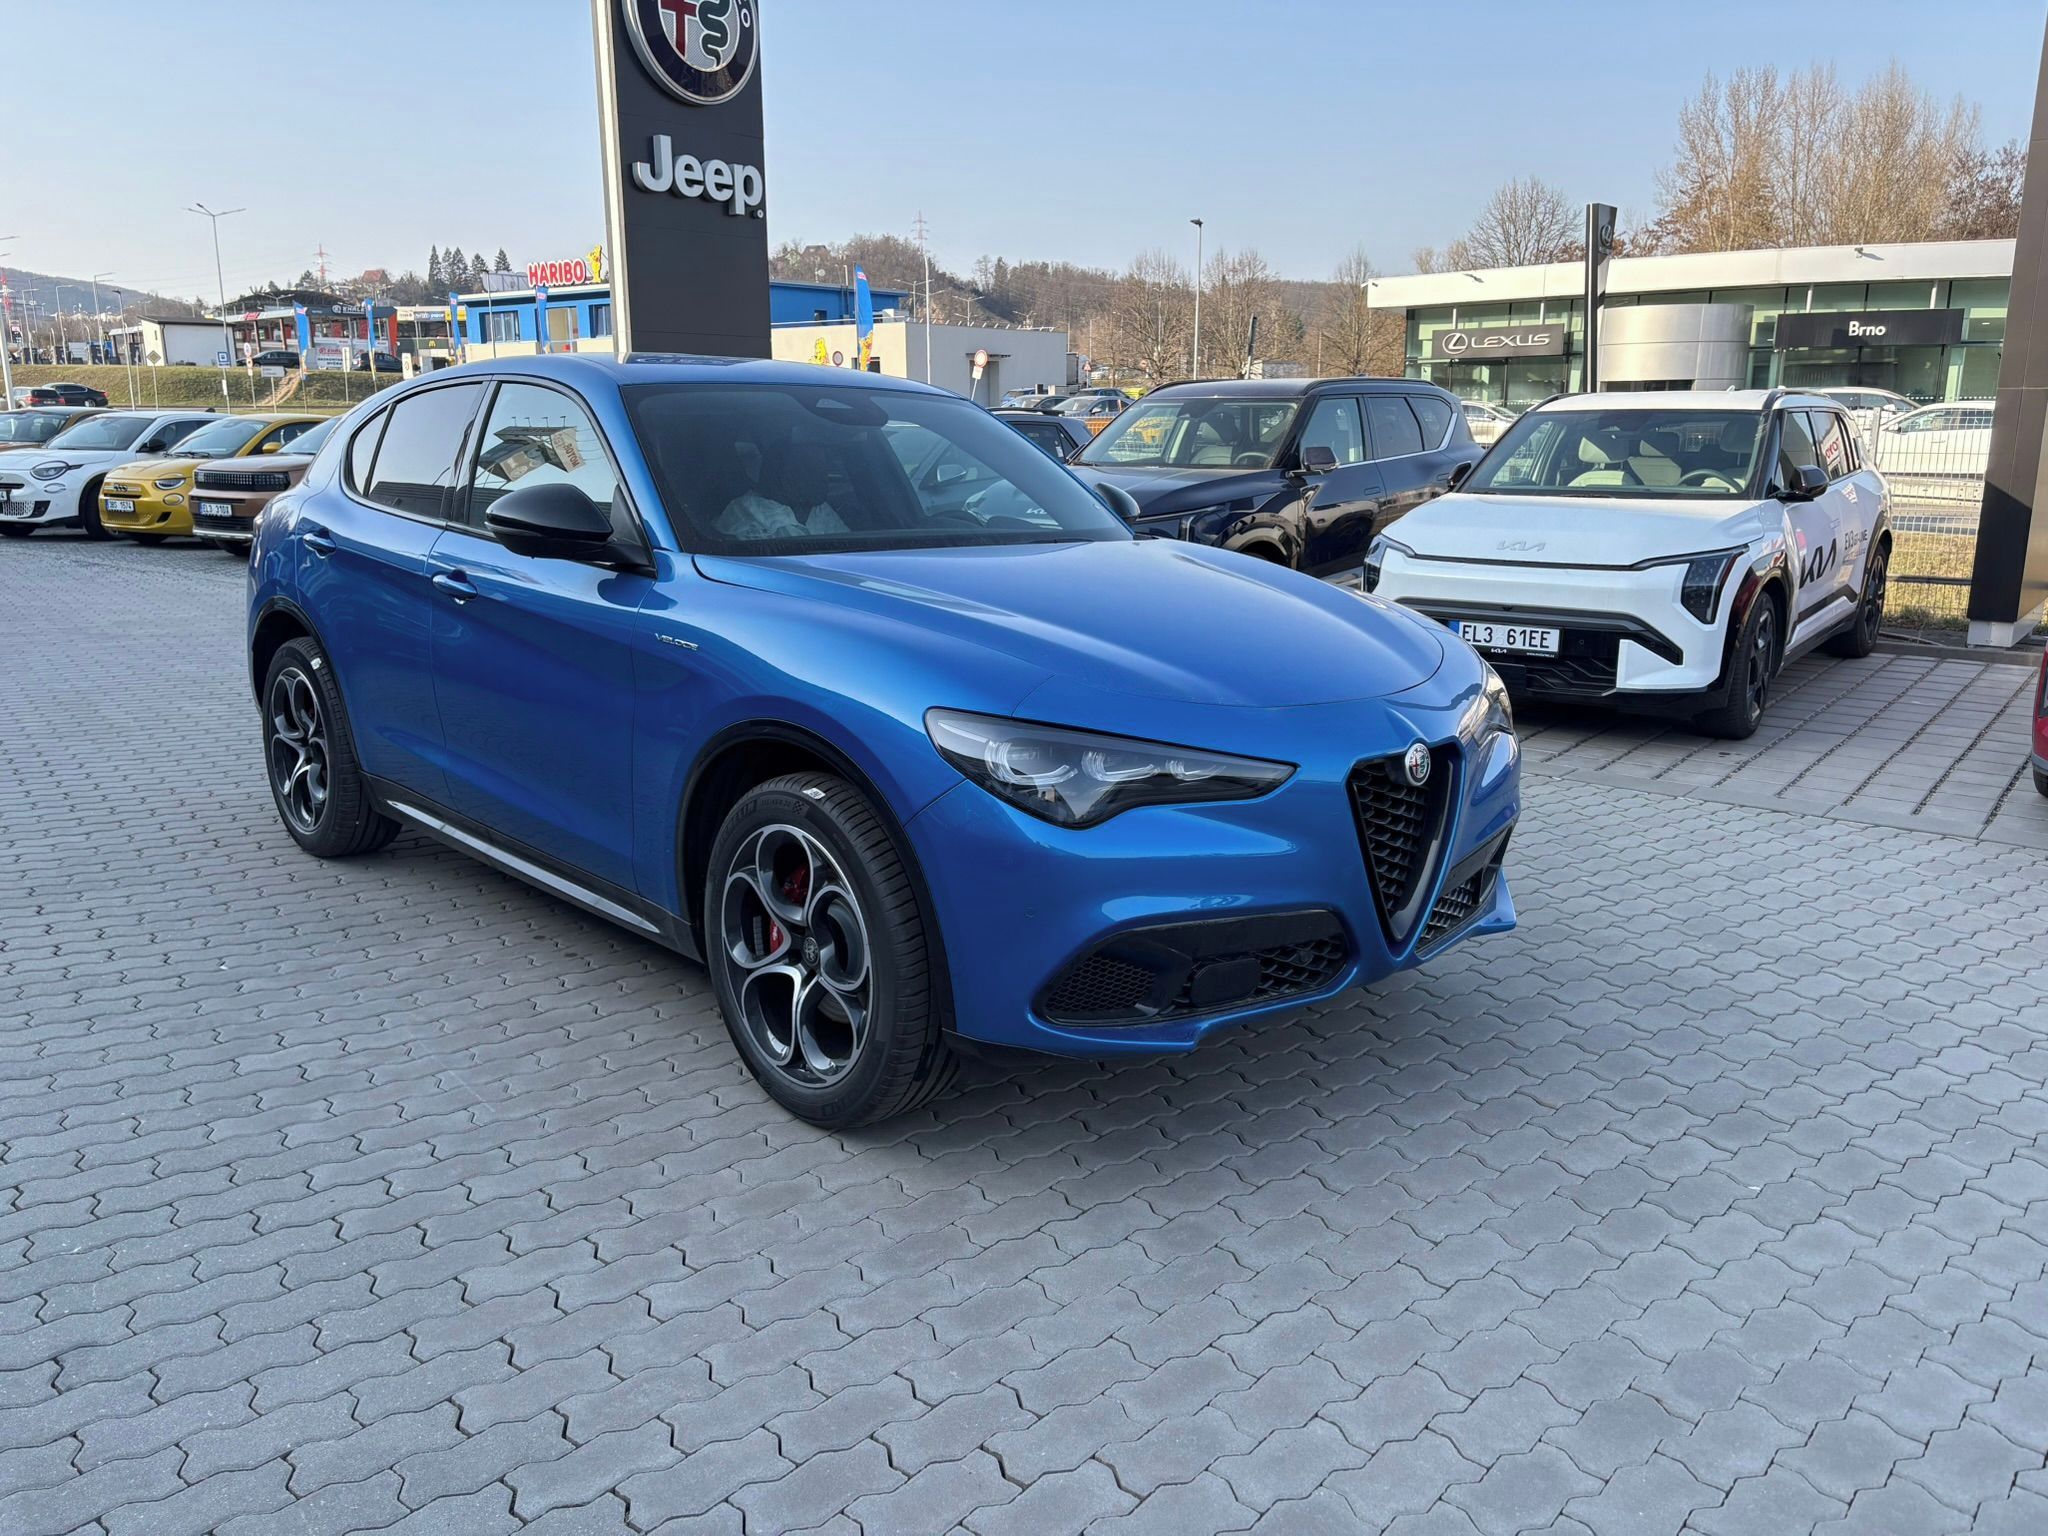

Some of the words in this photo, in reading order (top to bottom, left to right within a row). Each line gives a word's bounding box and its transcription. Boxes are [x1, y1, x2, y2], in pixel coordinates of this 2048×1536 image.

[632, 134, 764, 216] Jeep
[528, 259, 586, 287] HARIBO
[1471, 333, 1550, 348] LEXUS
[1848, 320, 1886, 336] Brno
[1799, 538, 1837, 590] KIA
[1462, 624, 1494, 644] EL3
[1507, 628, 1551, 649] 61EE
